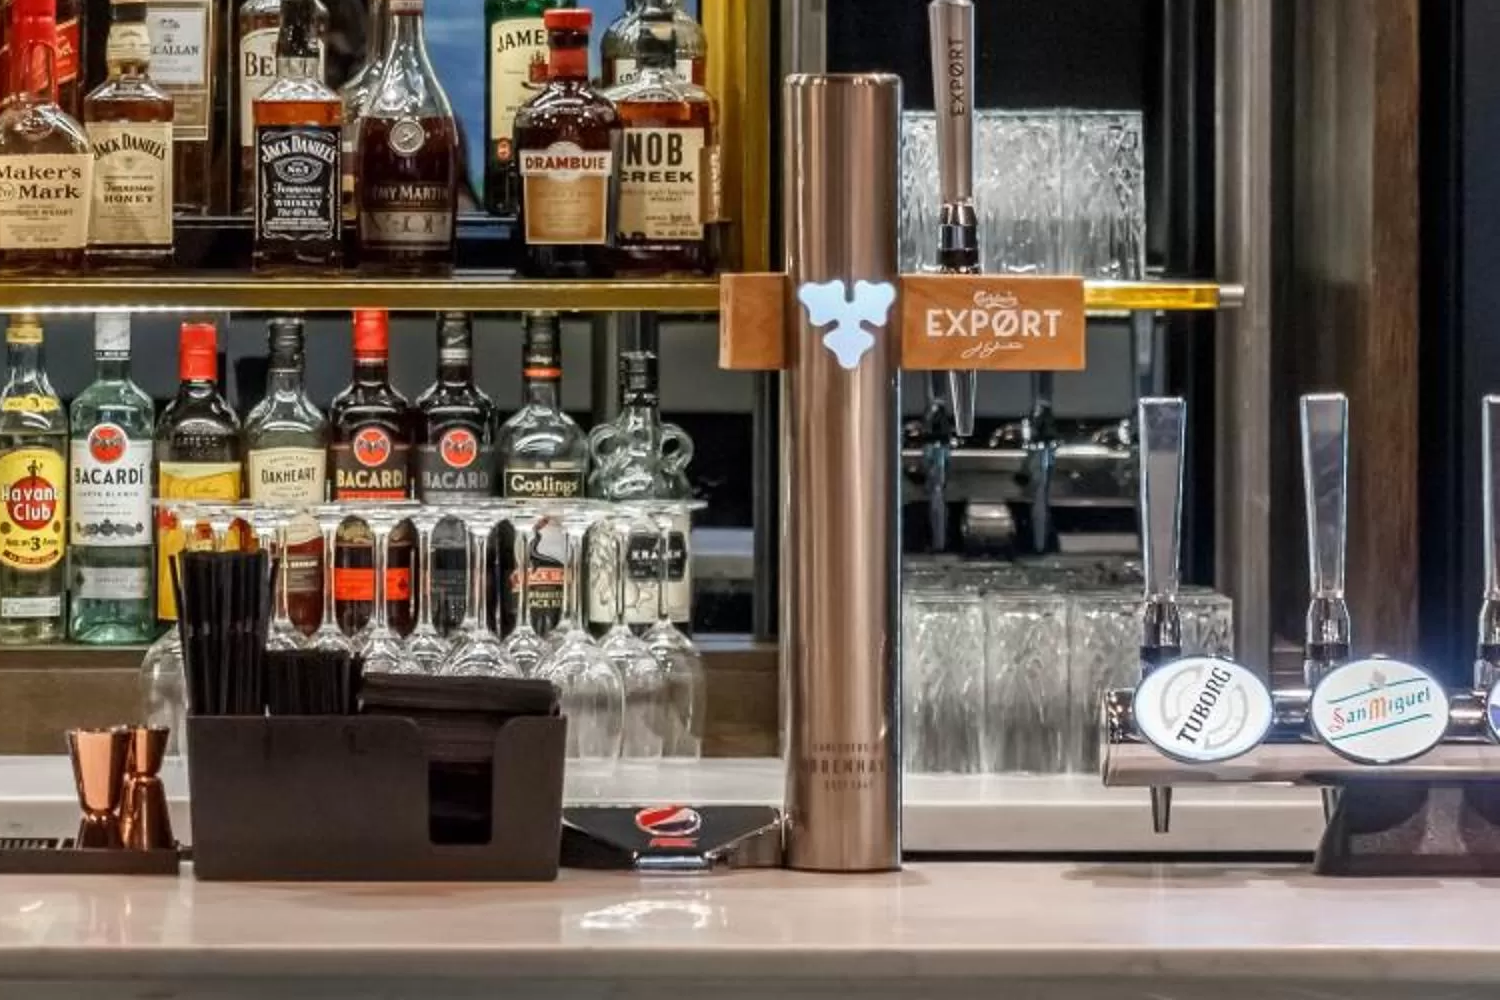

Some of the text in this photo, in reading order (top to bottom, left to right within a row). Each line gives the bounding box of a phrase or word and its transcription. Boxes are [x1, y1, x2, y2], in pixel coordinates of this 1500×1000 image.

[496, 28, 545, 52] JAME
[93, 137, 121, 161] JACK
[261, 139, 291, 163] JACK
[625, 132, 684, 167] NOB
[525, 155, 606, 171] DRAMBUIE
[18, 184, 84, 199] Mark
[925, 308, 1063, 338] EXPØRT
[261, 466, 317, 484] OAKHEART
[510, 473, 578, 497] Goslings
[14, 503, 51, 521] Club
[630, 549, 682, 559] KRAEN
[1175, 666, 1233, 745] TUBORG
